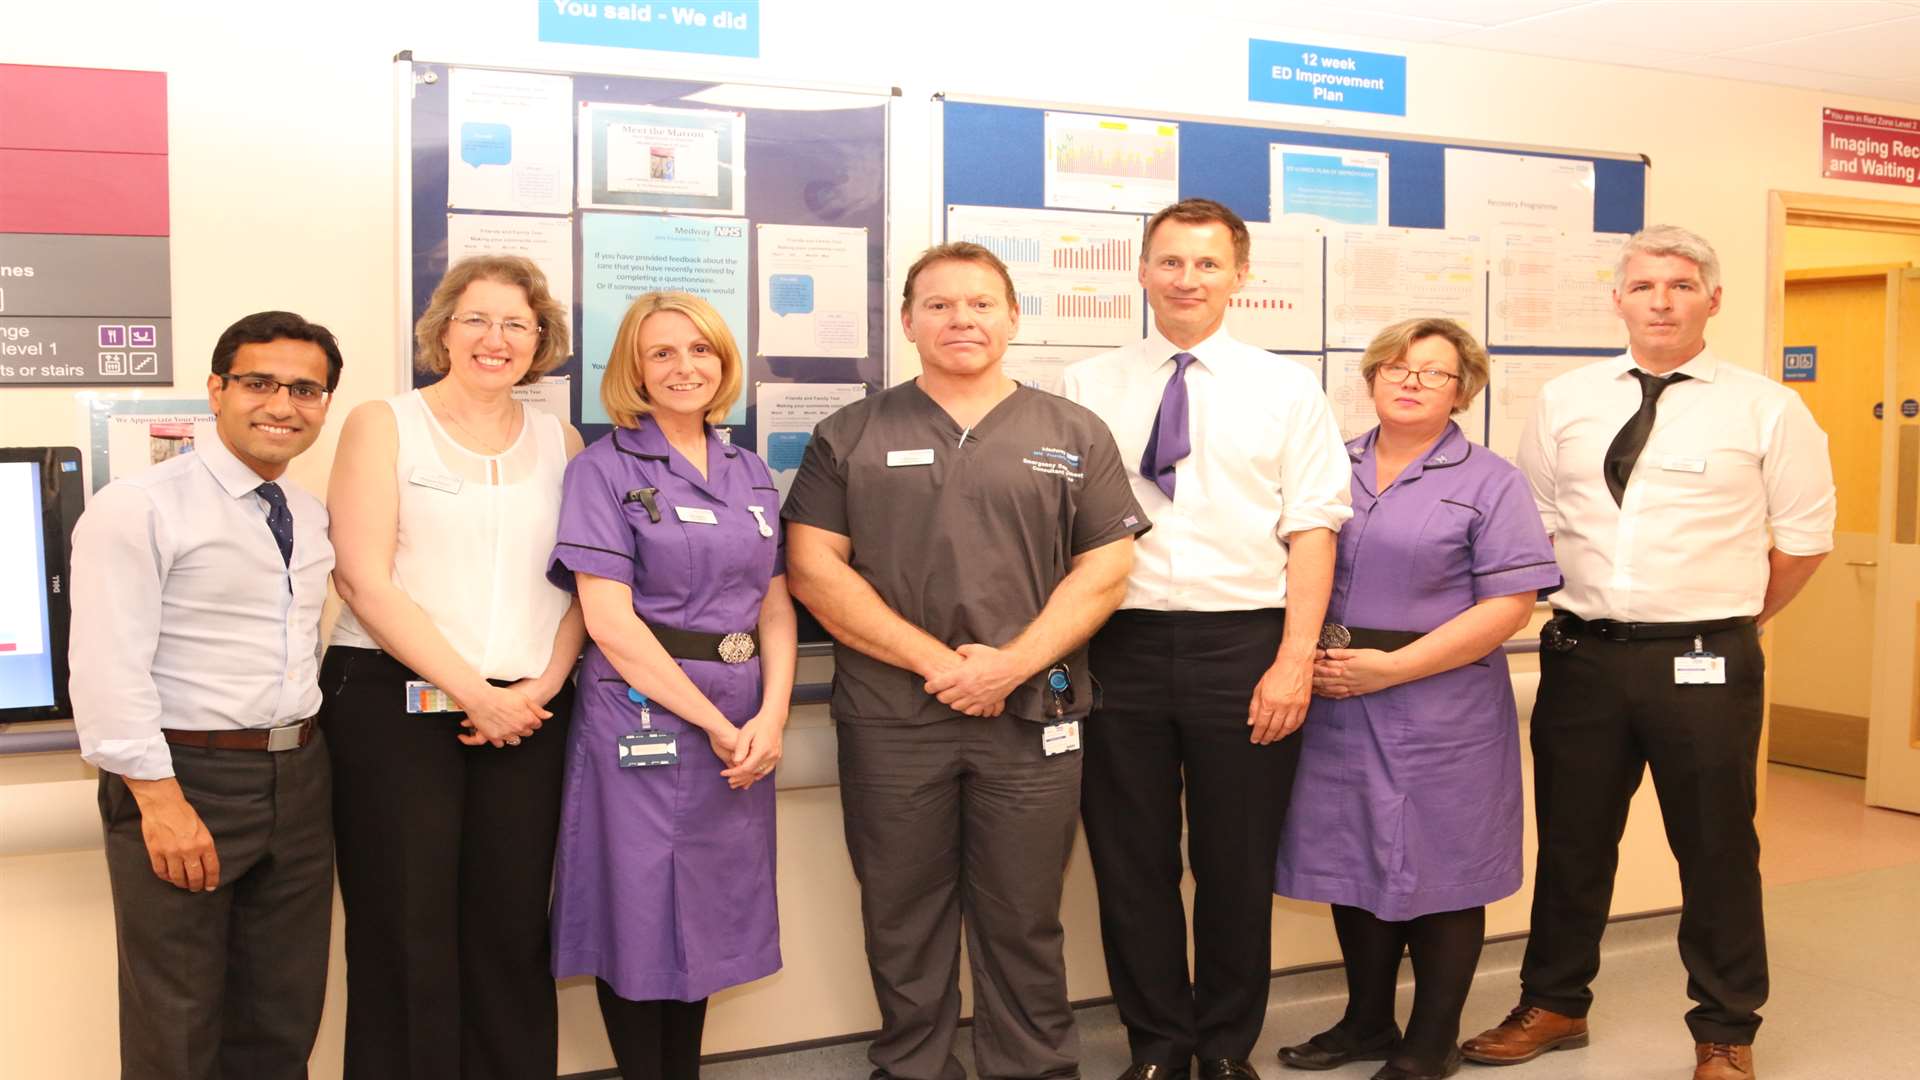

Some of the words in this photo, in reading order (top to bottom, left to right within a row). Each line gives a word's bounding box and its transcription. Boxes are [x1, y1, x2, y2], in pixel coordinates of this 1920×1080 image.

[554, 0, 597, 17] You
[604, 4, 652, 22] said
[671, 6, 707, 26] We
[713, 11, 747, 30] did
[1302, 53, 1318, 66] 12
[1321, 57, 1356, 71] week
[1272, 66, 1292, 80] ED
[1296, 68, 1384, 90] Improvement
[1313, 87, 1344, 102] Plan
[1863, 115, 1876, 124] Red
[650, 127, 664, 136] the
[1831, 132, 1889, 159] Imaging
[1830, 157, 1857, 173] and
[1861, 158, 1915, 183] Waiting
[716, 227, 741, 238] NHS
[616, 252, 635, 260] have
[636, 254, 668, 263] provided
[669, 254, 701, 264] feedback
[703, 256, 724, 264] about
[614, 262, 630, 270] that
[664, 264, 693, 274] recently
[694, 266, 724, 275] received
[726, 267, 735, 276] by
[616, 273, 657, 282] completing
[685, 286, 699, 294] you
[2, 342, 43, 355] level
[49, 342, 58, 355] 1
[19, 366, 37, 376] or
[41, 364, 85, 377] stairs
[1023, 457, 1056, 469] Emergency
[53, 575, 61, 593] DELL
